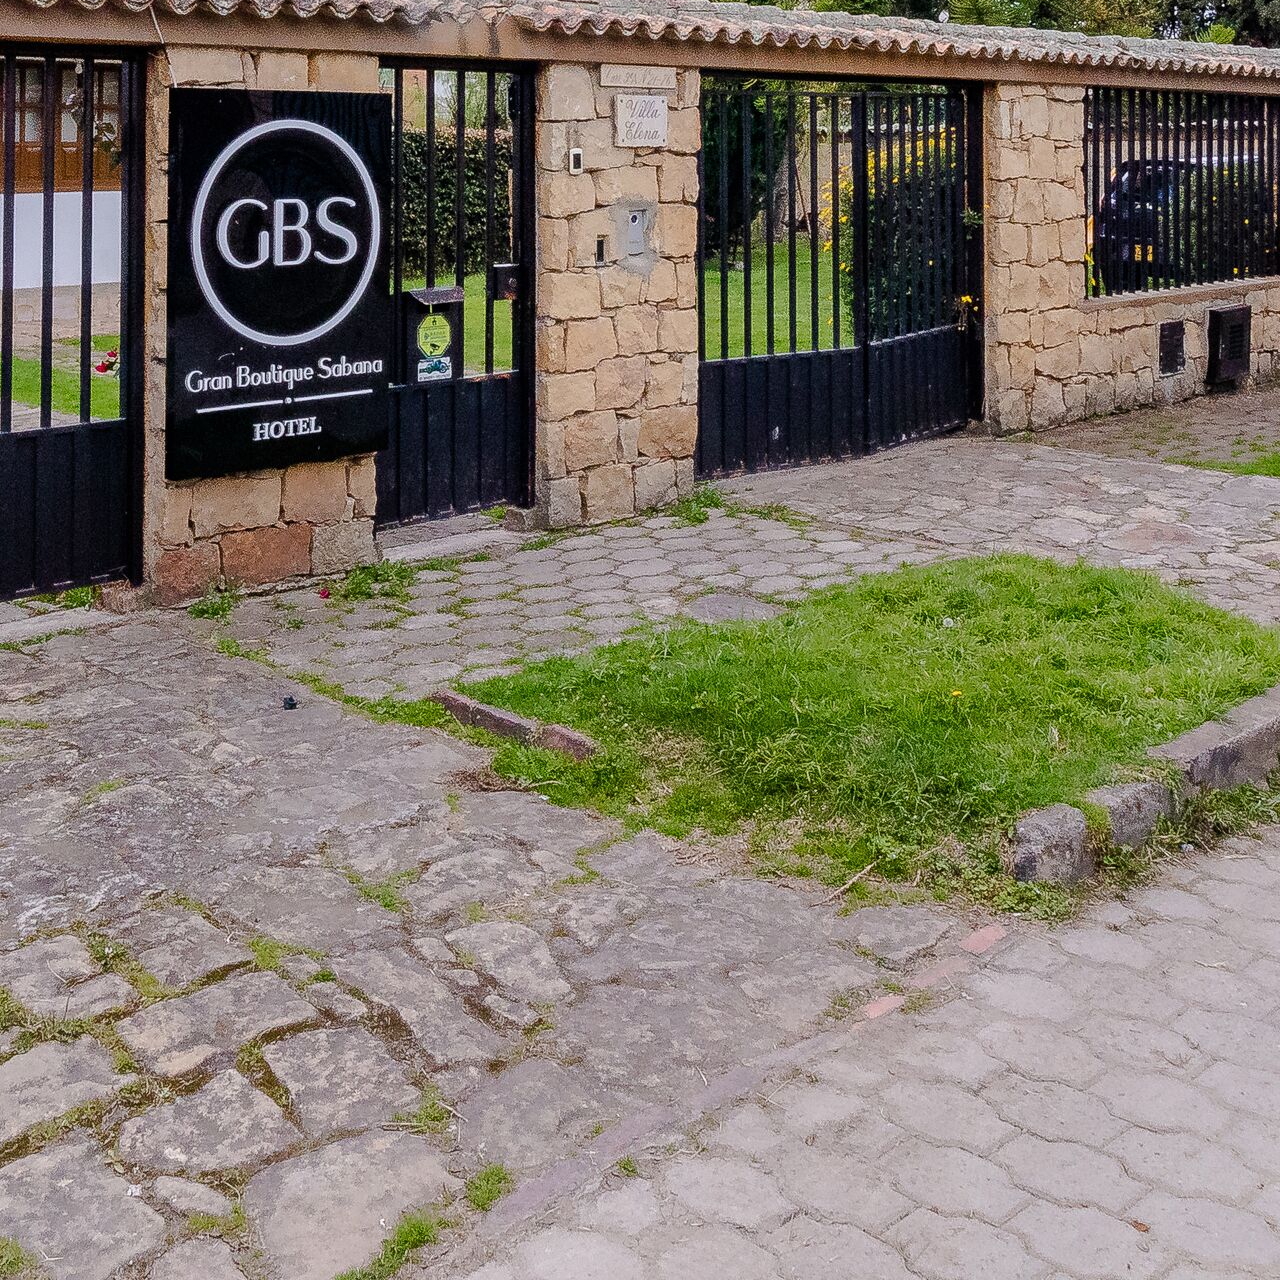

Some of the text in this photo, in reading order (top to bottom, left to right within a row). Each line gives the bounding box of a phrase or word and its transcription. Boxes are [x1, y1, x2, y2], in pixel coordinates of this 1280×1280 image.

[625, 99, 661, 119] Villa
[624, 120, 660, 140] Elena
[216, 196, 358, 269] GBS
[185, 355, 383, 393] Gran Boutique Sabana
[252, 416, 322, 441] HOTEL
